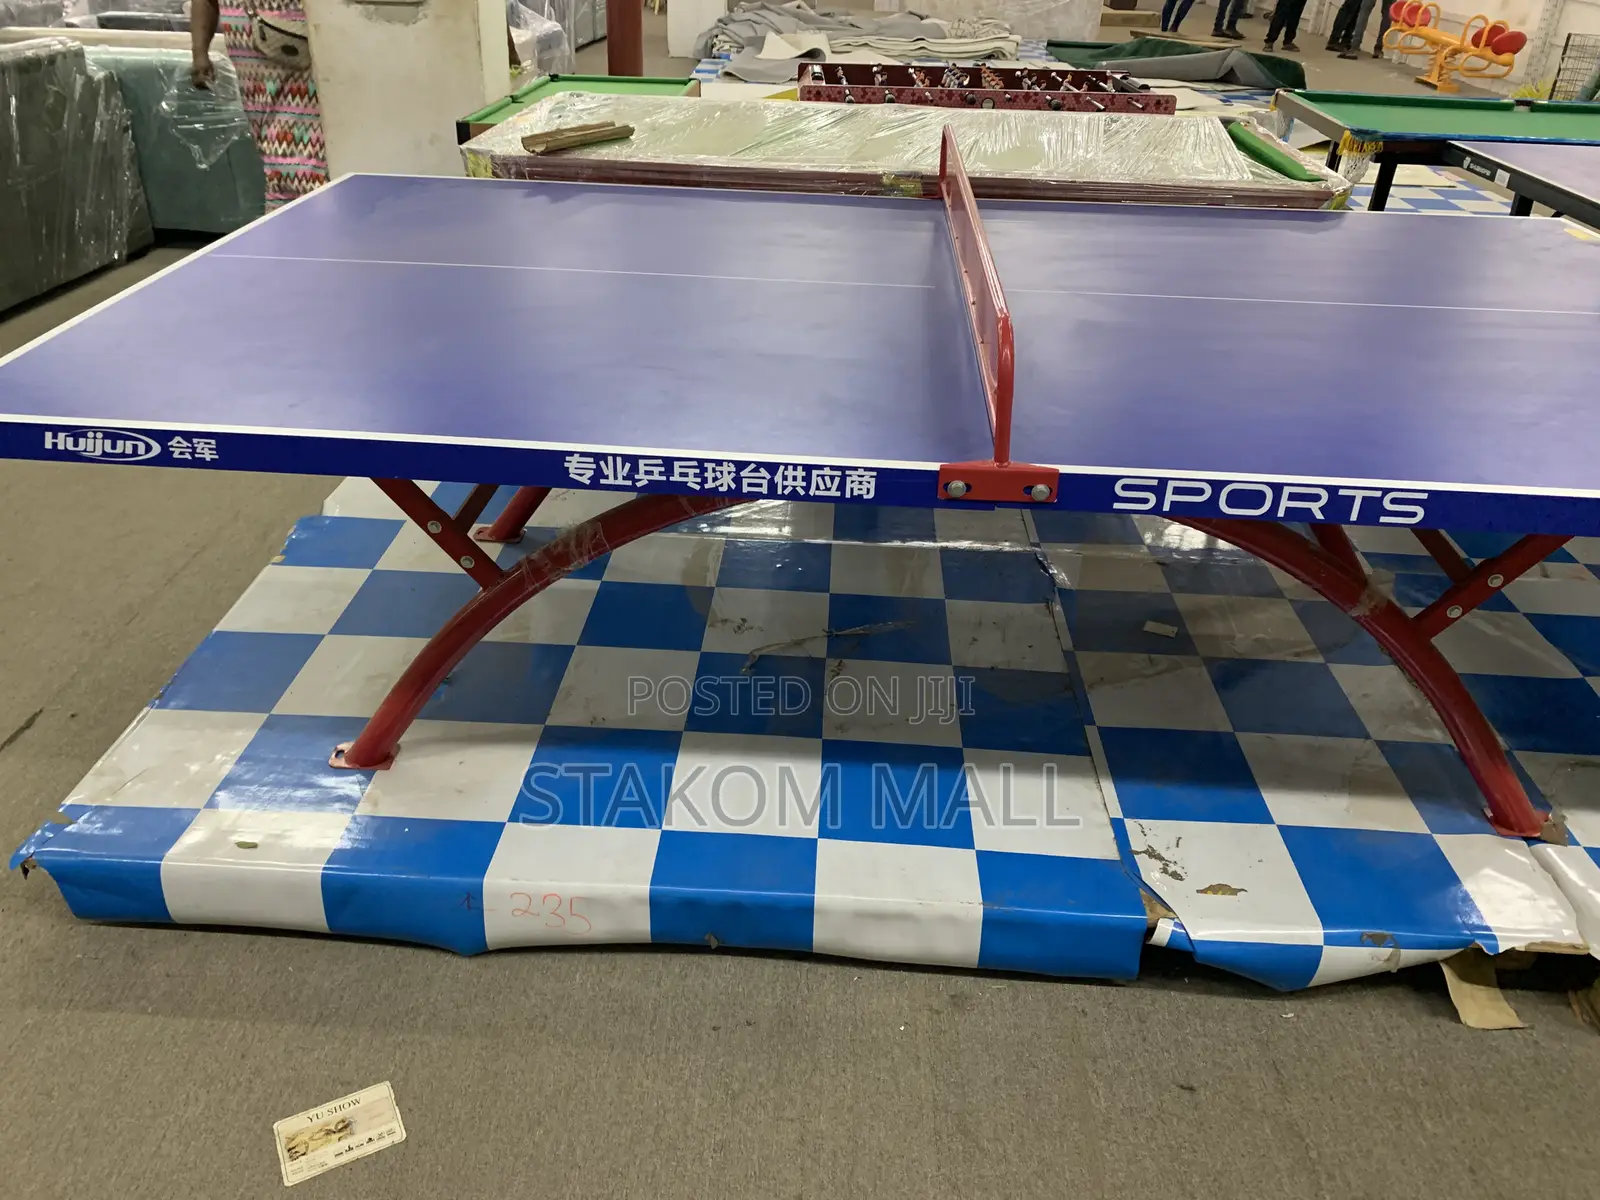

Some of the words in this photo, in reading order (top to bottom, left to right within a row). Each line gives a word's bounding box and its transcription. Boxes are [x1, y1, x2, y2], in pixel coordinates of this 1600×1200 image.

[44, 431, 146, 457] Huijun
[167, 435, 219, 462] 会军
[563, 453, 878, 500] 专业乒乓球台供应商
[1112, 477, 1429, 525] SPORTS
[509, 892, 592, 936] 235
[306, 1111, 325, 1123] YU
[326, 1097, 362, 1117] SHOW
